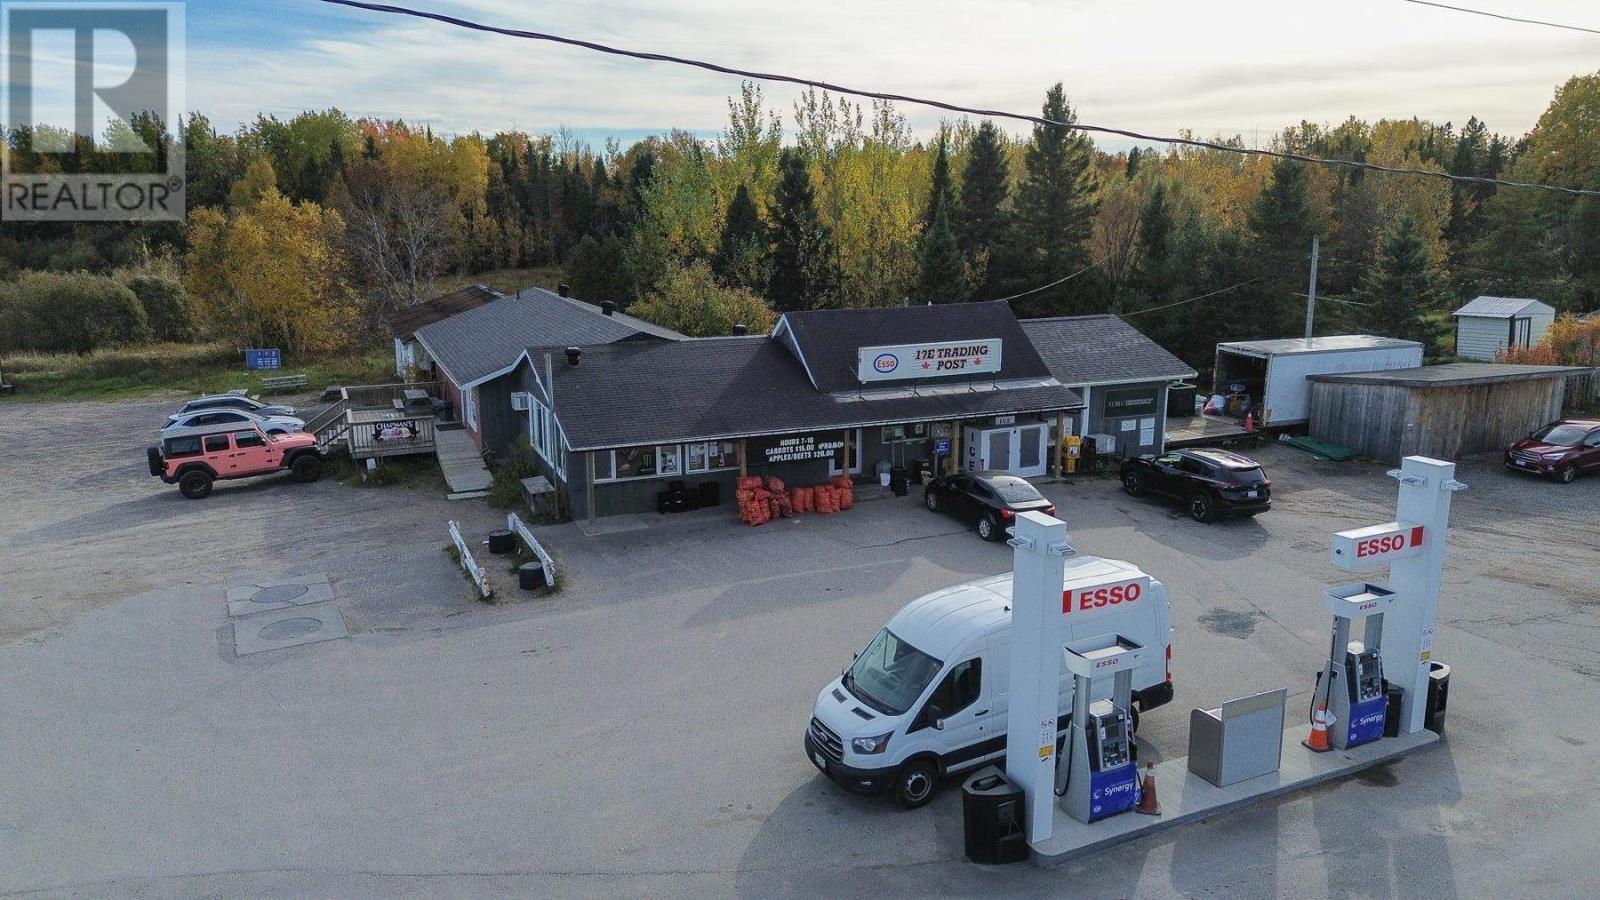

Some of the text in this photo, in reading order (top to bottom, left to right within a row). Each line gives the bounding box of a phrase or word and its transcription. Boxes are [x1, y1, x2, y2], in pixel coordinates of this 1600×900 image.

[916, 345, 989, 360] 17E TRADING
[937, 359, 967, 370] POST
[780, 438, 800, 446] HOURS
[765, 446, 794, 455] CARROTS
[769, 451, 812, 462] APPLES/BEETS
[1357, 534, 1405, 558] ESSO
[1080, 583, 1141, 611] ESSO
[1360, 602, 1377, 610] ESSO
[1095, 658, 1119, 668] ESSO
[1359, 713, 1384, 726] Synergy
[1104, 781, 1134, 797] Synergy
